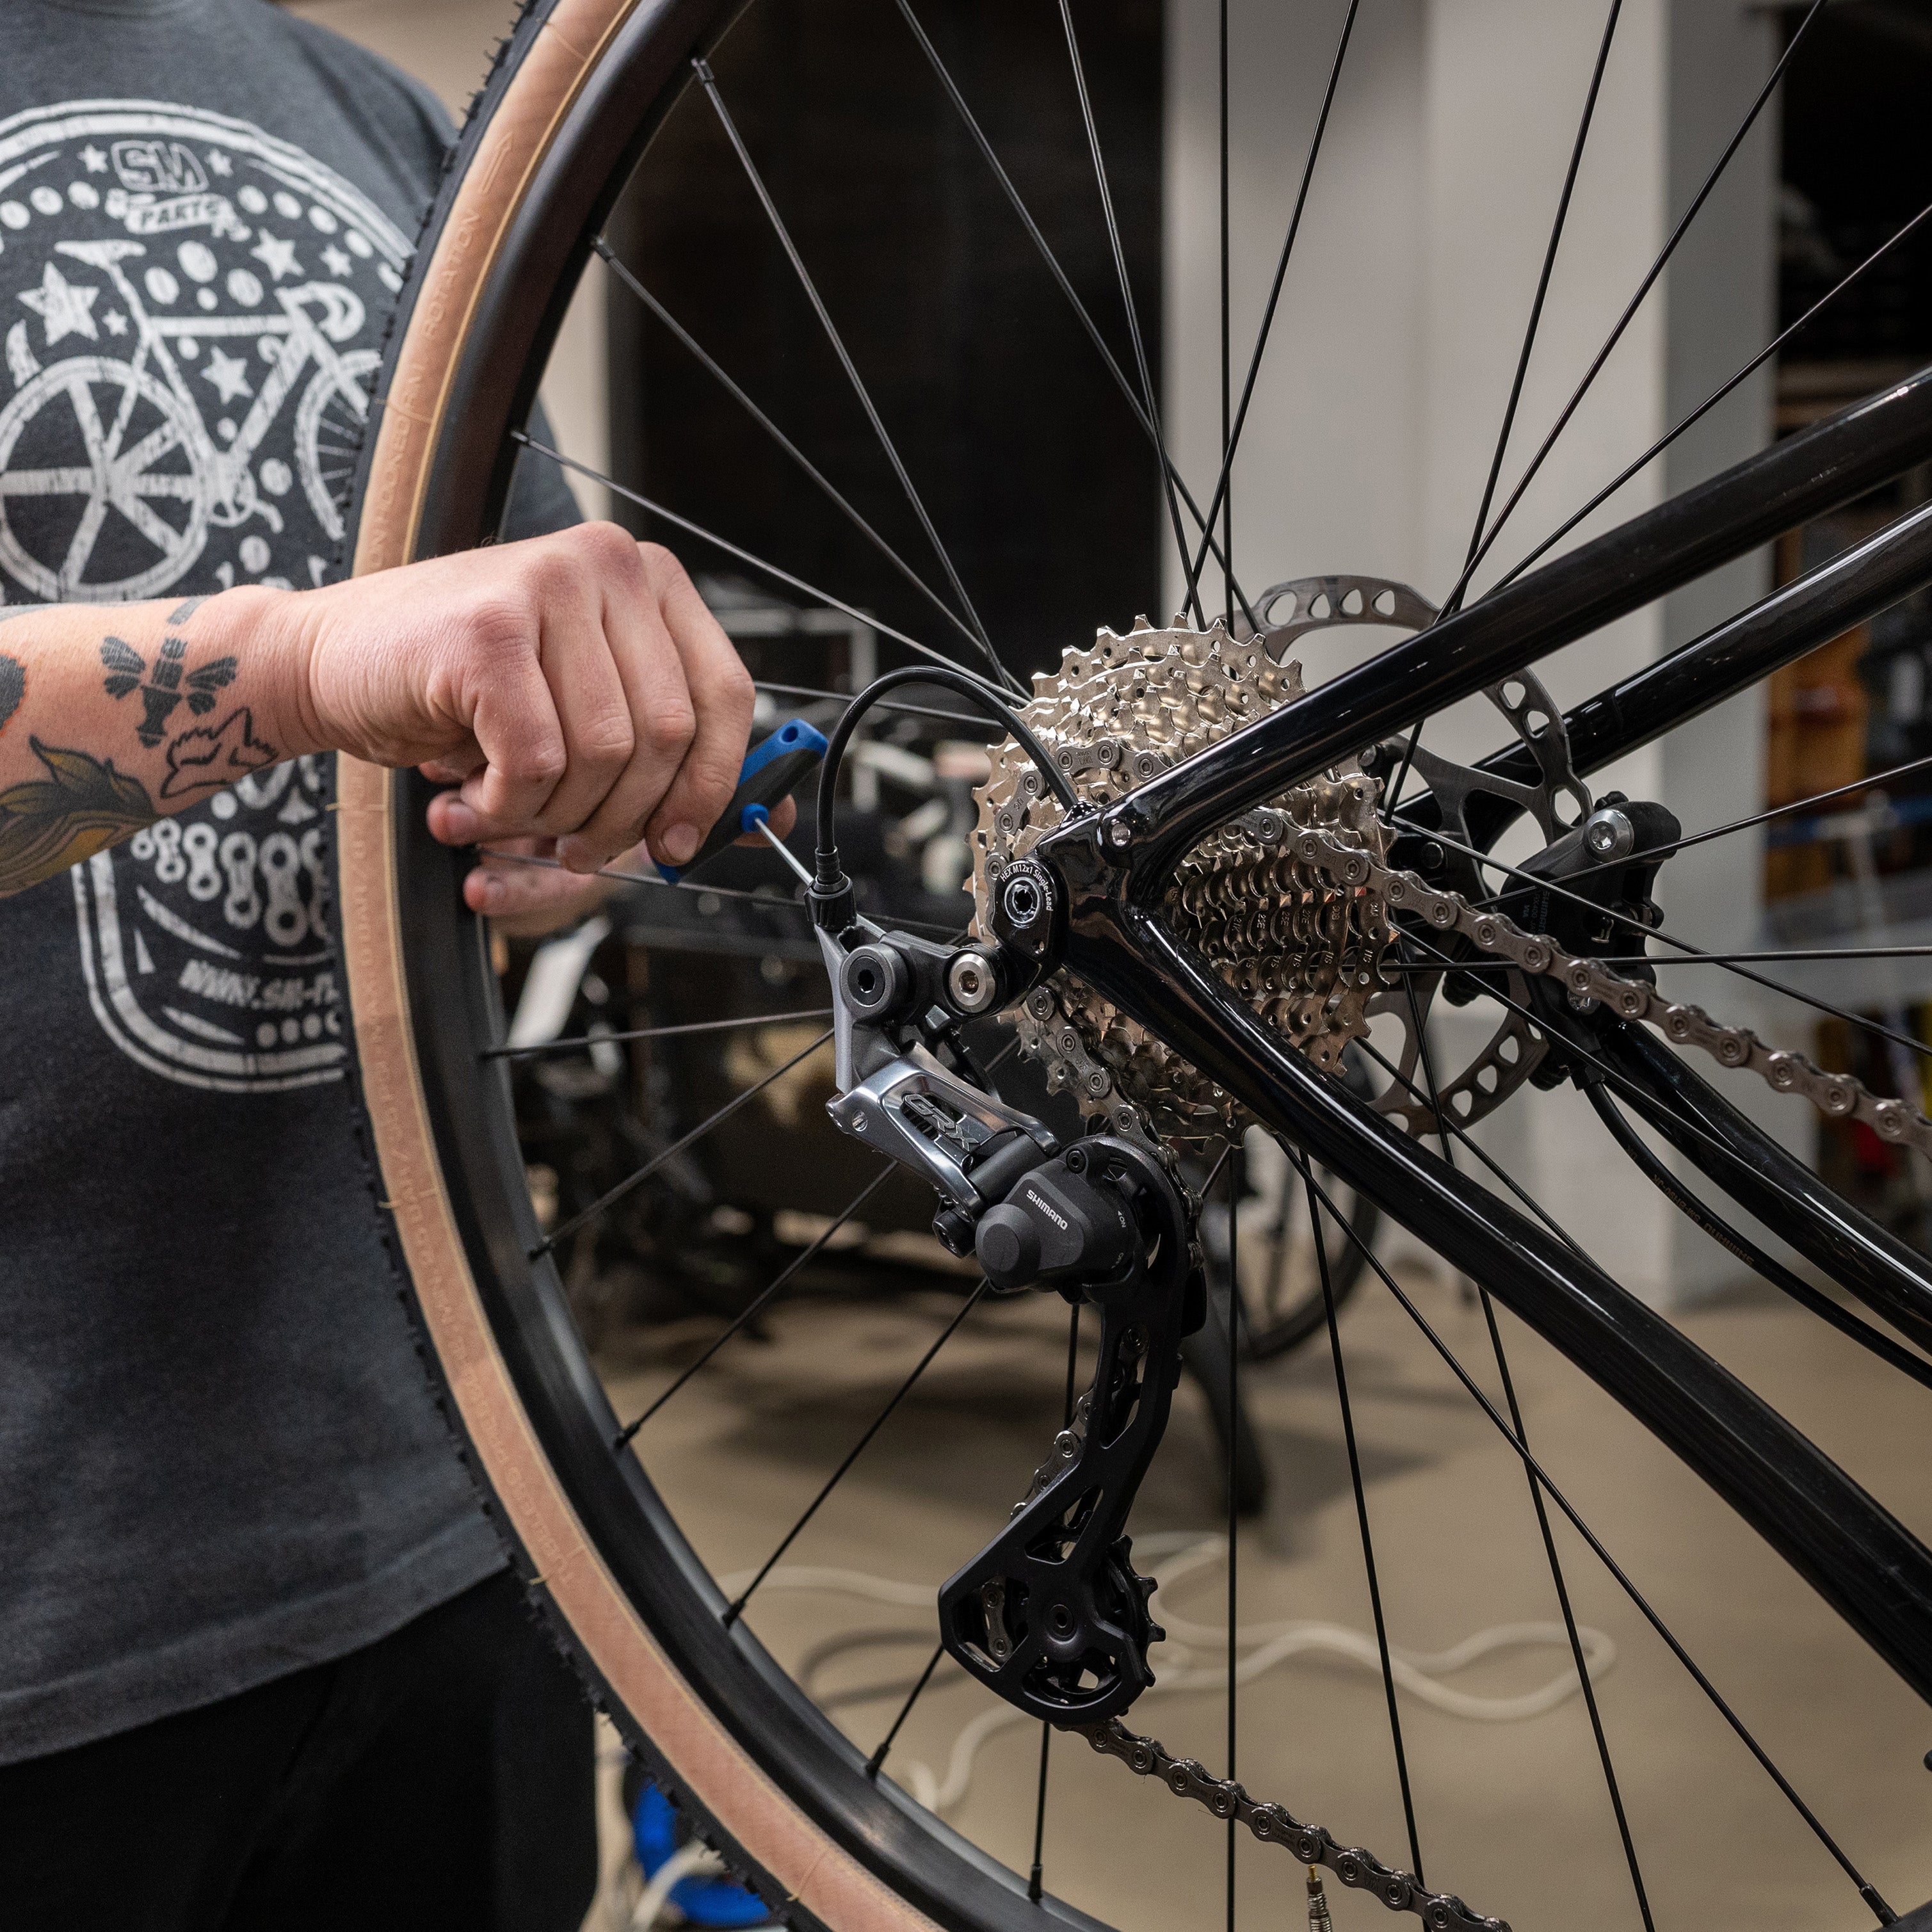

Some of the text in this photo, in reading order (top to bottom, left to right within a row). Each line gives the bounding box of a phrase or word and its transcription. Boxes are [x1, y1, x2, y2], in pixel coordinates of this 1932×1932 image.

[110, 140, 209, 192] SM
[423, 211, 480, 337] ROTATION
[1000, 864, 1054, 912] HEX M12x1 Single-Lead
[1538, 890, 1550, 934] SHIMAN
[905, 1093, 979, 1152] GRX
[1026, 1189, 1068, 1230] SHIMANO
[1119, 1216, 1126, 1228] ON
[1703, 1223, 1754, 1266] SHIMANO
